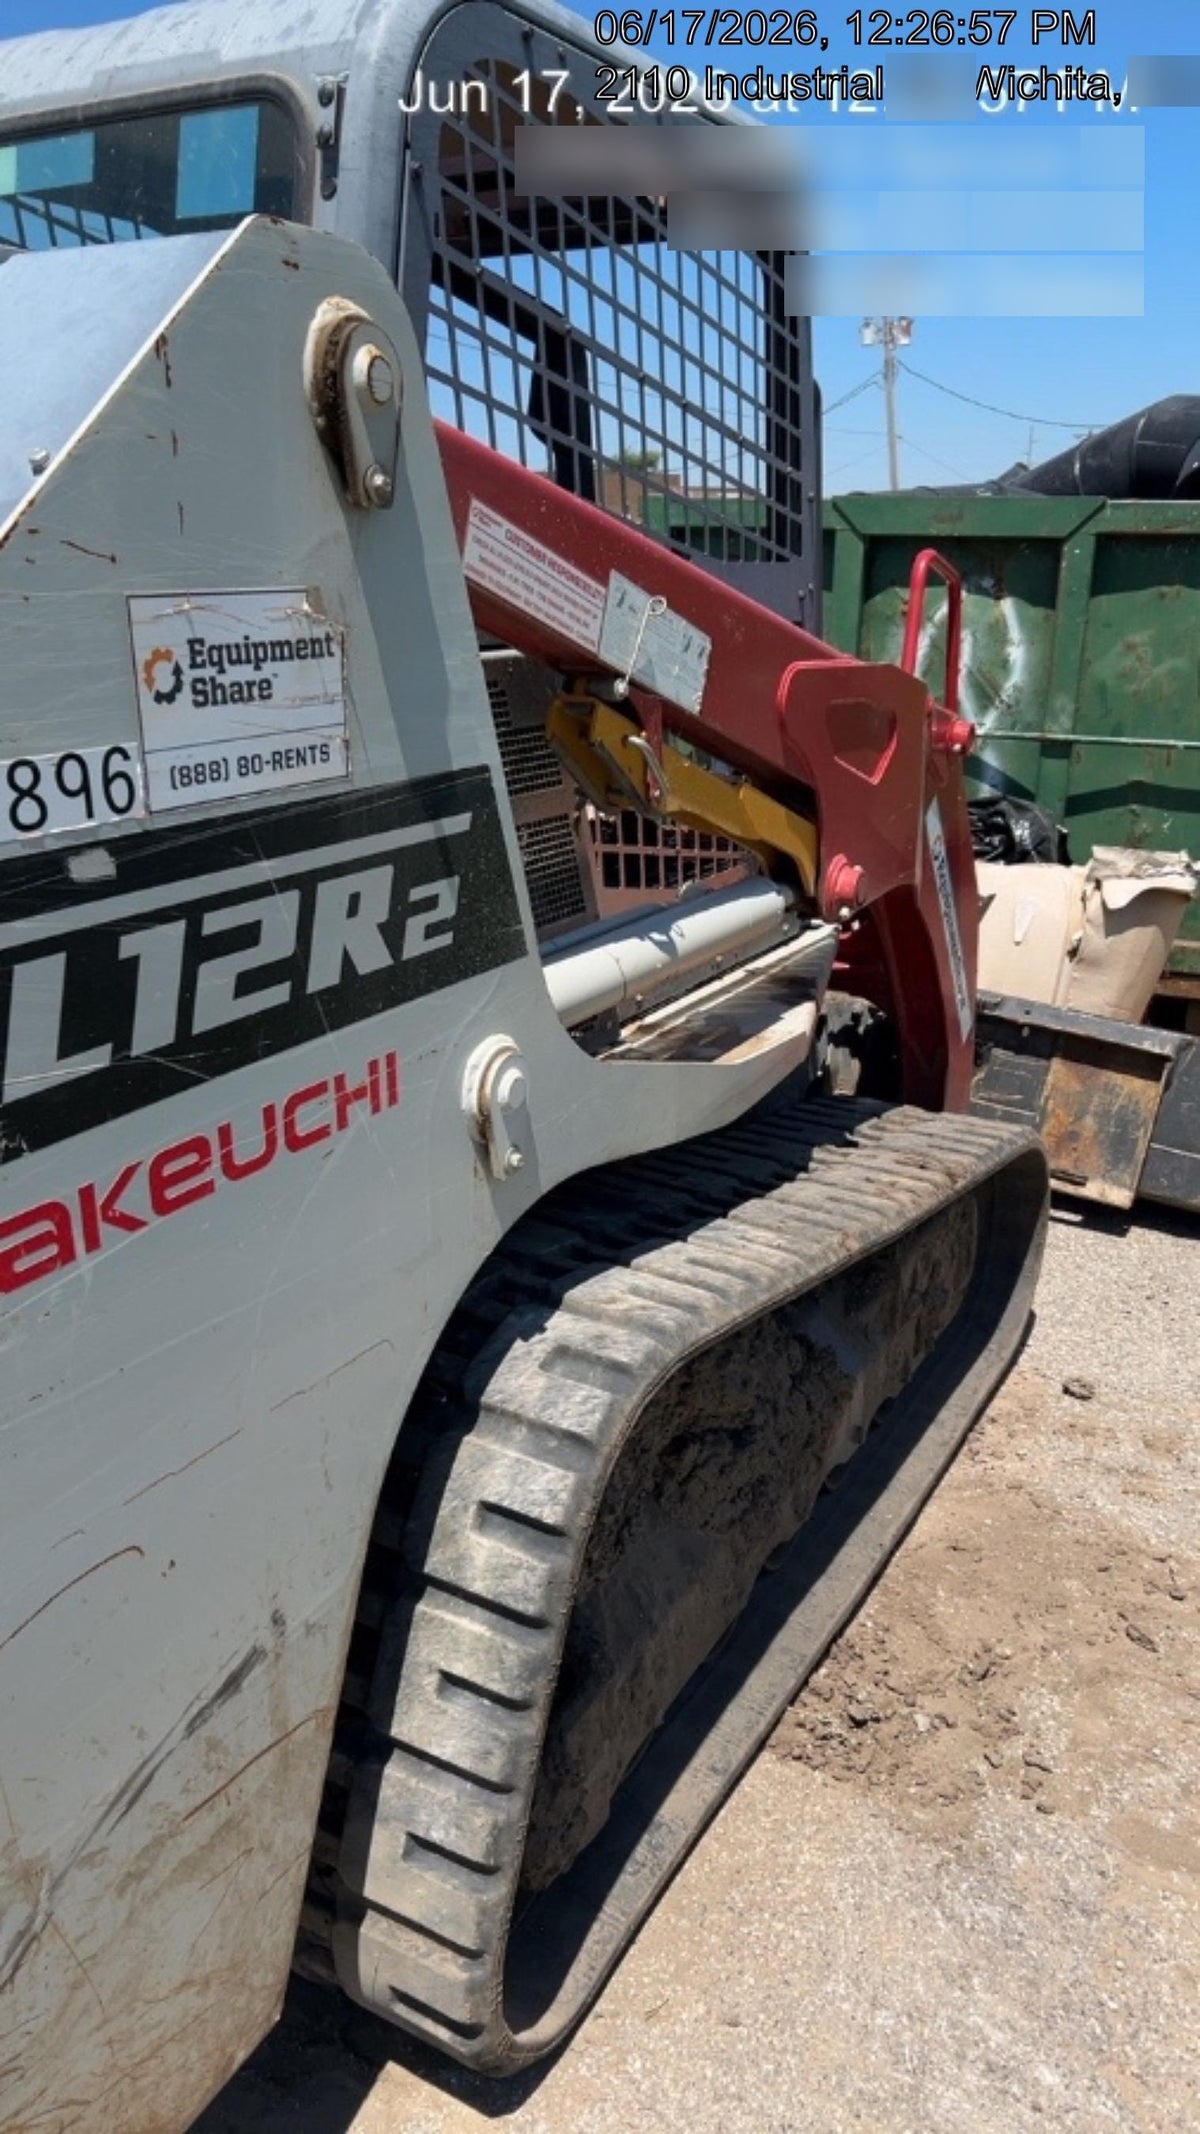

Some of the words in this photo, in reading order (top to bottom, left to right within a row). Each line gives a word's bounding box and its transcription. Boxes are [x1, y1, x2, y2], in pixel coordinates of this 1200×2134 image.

[187, 632, 335, 674] Equipment
[190, 675, 274, 708] Share
[170, 757, 230, 790] (888)
[236, 743, 331, 777] 80-RENTS
[7, 746, 135, 832] 896
